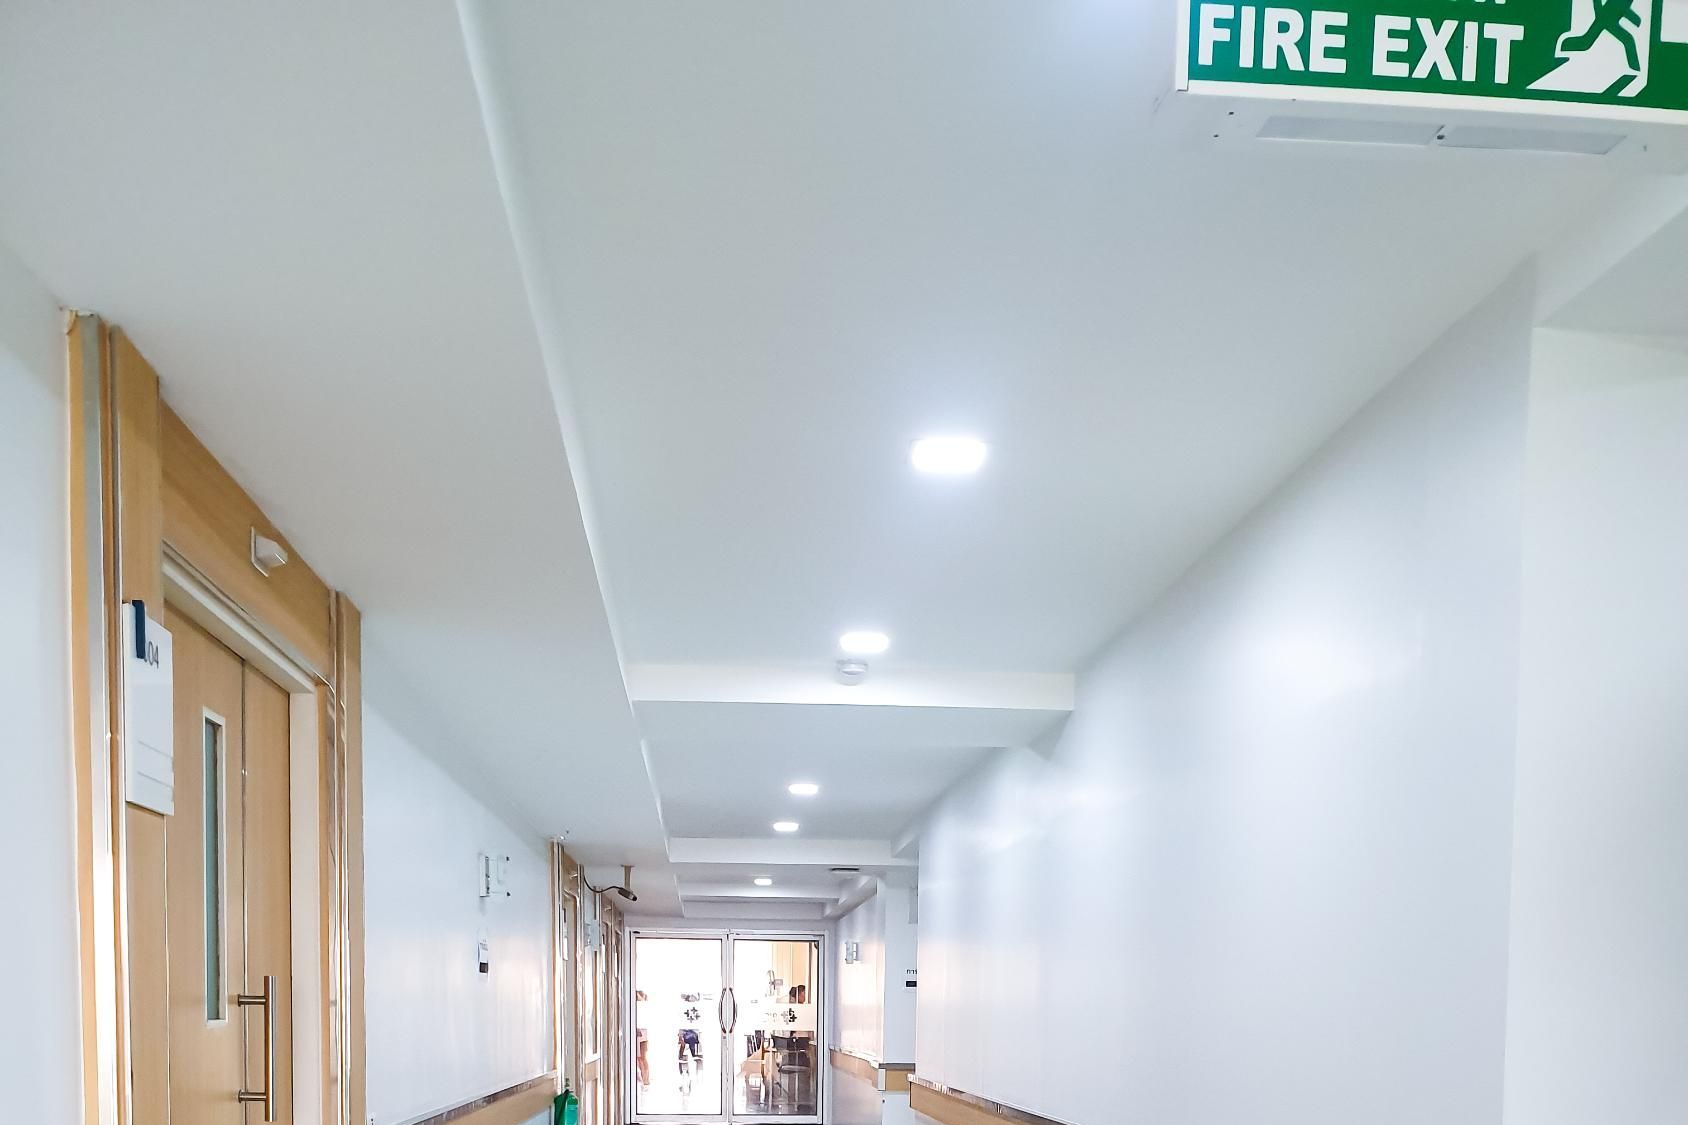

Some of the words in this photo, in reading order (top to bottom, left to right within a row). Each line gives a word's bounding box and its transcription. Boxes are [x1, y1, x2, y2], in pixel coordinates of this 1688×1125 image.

[1198, 4, 1348, 74] FIRE
[1372, 14, 1524, 84] EXIT
[144, 640, 159, 669] 04
